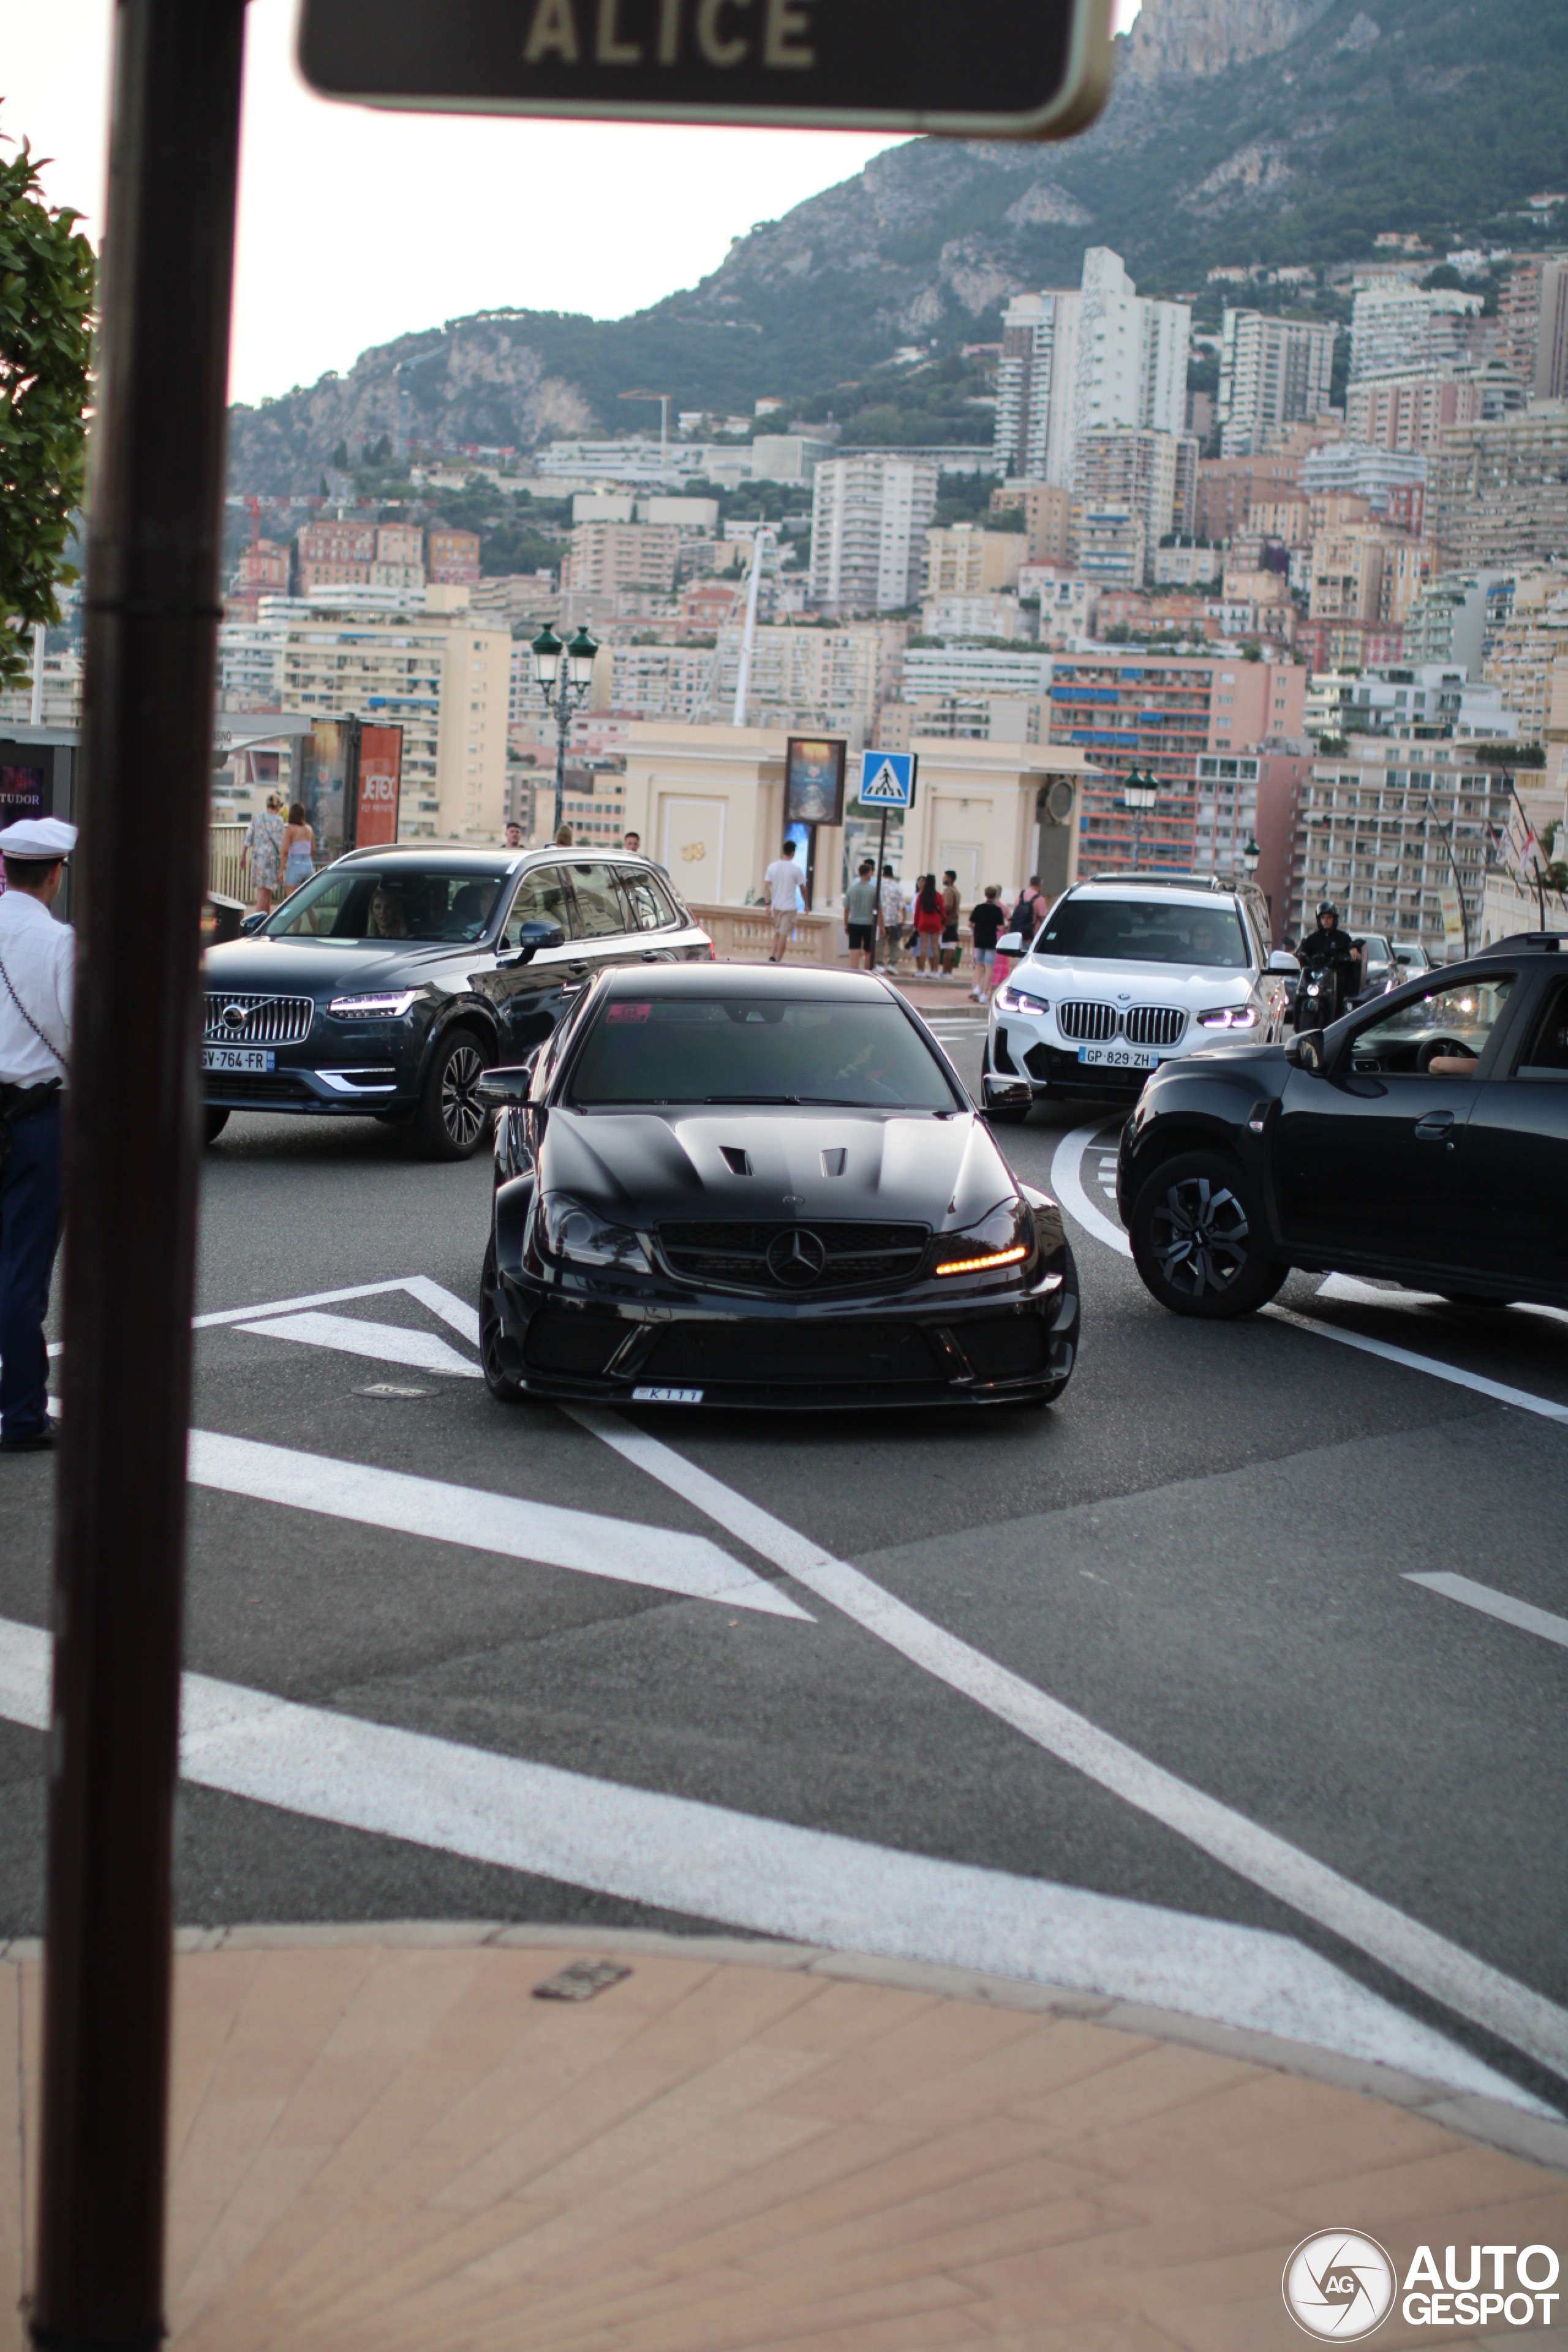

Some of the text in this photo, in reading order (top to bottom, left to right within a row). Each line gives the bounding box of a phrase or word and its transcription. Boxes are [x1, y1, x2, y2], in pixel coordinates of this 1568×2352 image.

[523, 0, 815, 67] ALICE
[0, 793, 40, 805] TUDOR
[362, 775, 395, 801] JETEX
